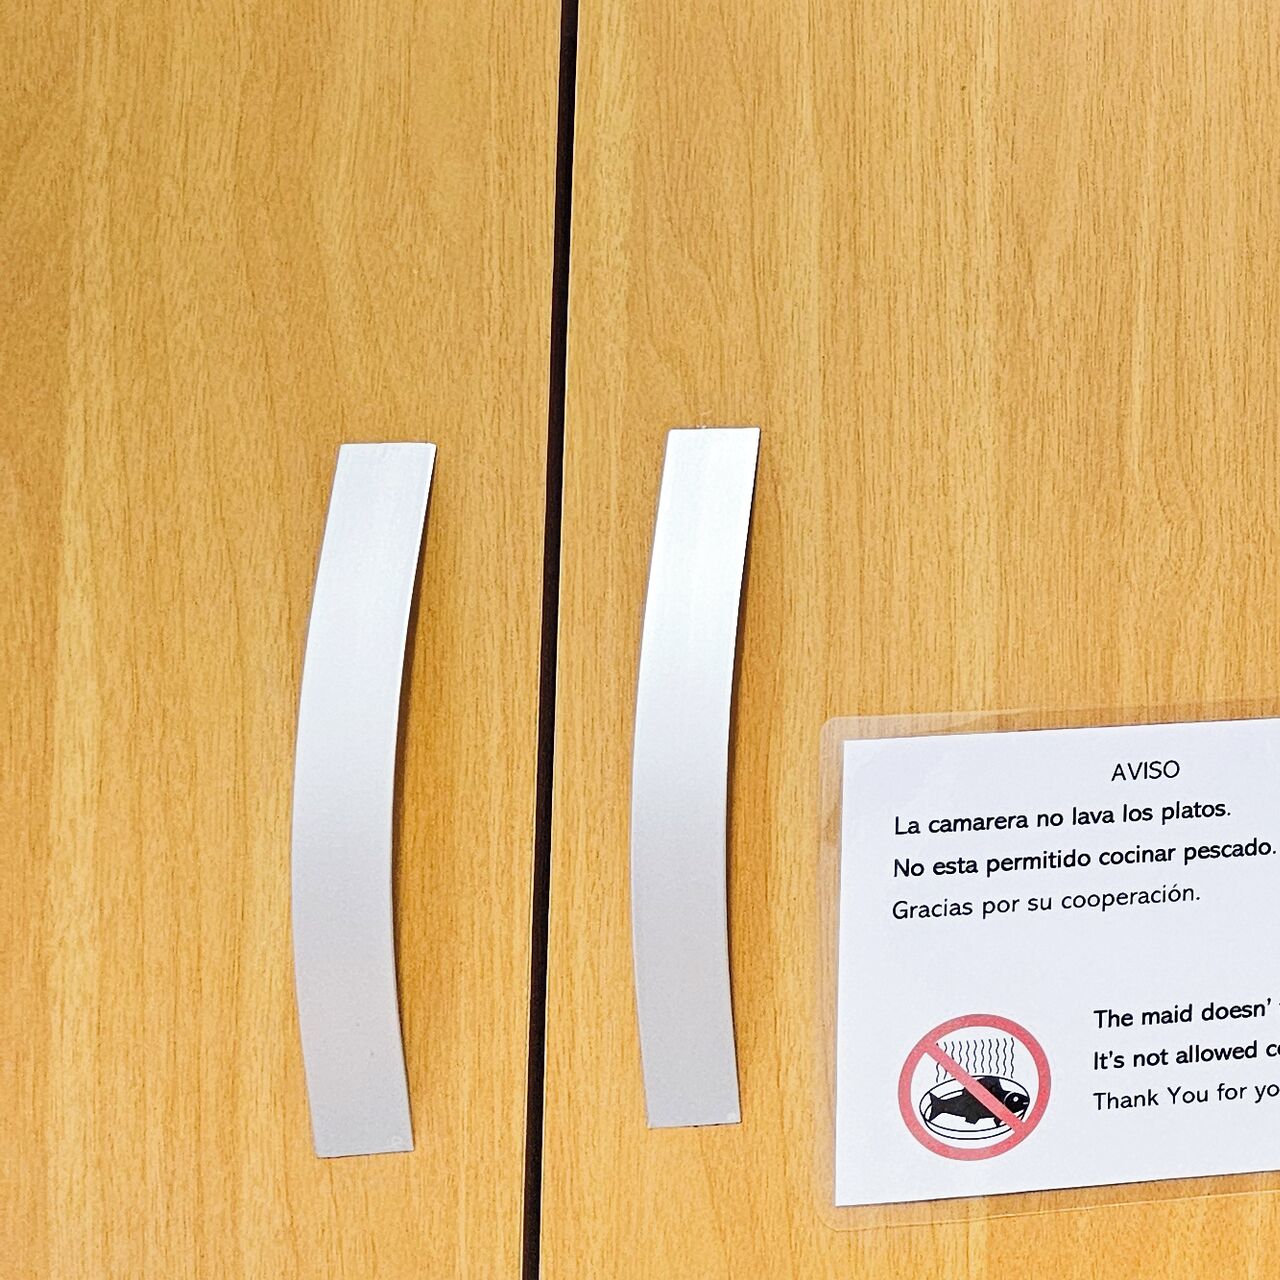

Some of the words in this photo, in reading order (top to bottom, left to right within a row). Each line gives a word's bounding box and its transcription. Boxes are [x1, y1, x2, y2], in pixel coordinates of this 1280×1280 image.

[1112, 760, 1180, 781] AVISO
[895, 816, 920, 835] La
[929, 815, 1028, 833] camarera
[1037, 813, 1063, 827] no
[1073, 807, 1115, 825] lava
[1123, 804, 1153, 822] los
[1162, 801, 1230, 825] platos.
[894, 859, 924, 877] No
[933, 858, 978, 875] esta
[987, 849, 1091, 878] permitido
[1099, 845, 1176, 865] cocinar
[1185, 838, 1276, 865] pescado.
[893, 899, 972, 919] Gracias
[983, 899, 1019, 919] por
[1028, 898, 1051, 911] su
[1062, 884, 1200, 912] cooperación.
[1094, 1009, 1133, 1028] The
[1142, 1004, 1192, 1025] maid
[1094, 1051, 1124, 1070] It's
[1134, 1049, 1168, 1067] not
[1176, 1040, 1257, 1064] allowed
[1093, 1089, 1159, 1110] Thank
[1167, 1087, 1208, 1104] You
[1217, 1083, 1247, 1100] for
